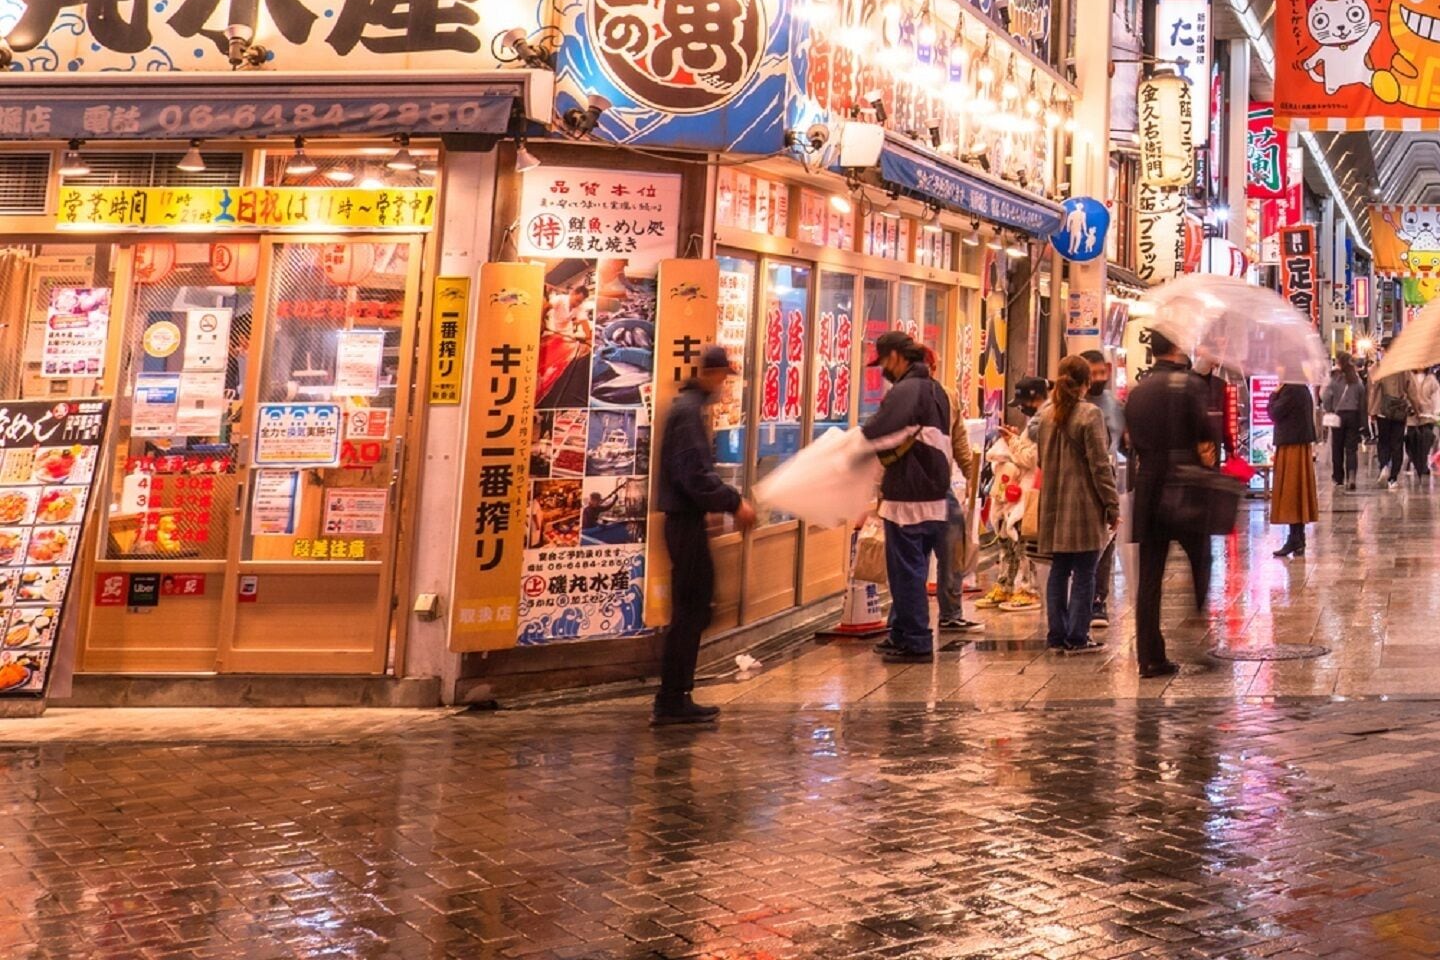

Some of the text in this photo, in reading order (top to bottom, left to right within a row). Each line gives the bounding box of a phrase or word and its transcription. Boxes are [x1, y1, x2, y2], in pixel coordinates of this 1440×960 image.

[83, 104, 141, 135] 電話
[158, 101, 484, 135] 06-6484-2850
[1141, 83, 1163, 179] 金久右衛門
[549, 180, 656, 198] 品質本位
[63, 191, 148, 224] 営業時間
[532, 216, 562, 250] 特
[567, 216, 665, 237] 鮮魚・めし処
[566, 236, 638, 253] 磯丸焼き
[438, 311, 459, 378] 一番搾り
[474, 343, 522, 571] キリン一番搾り
[134, 583, 155, 593] Uber
[548, 570, 631, 595] 磯丸水産
